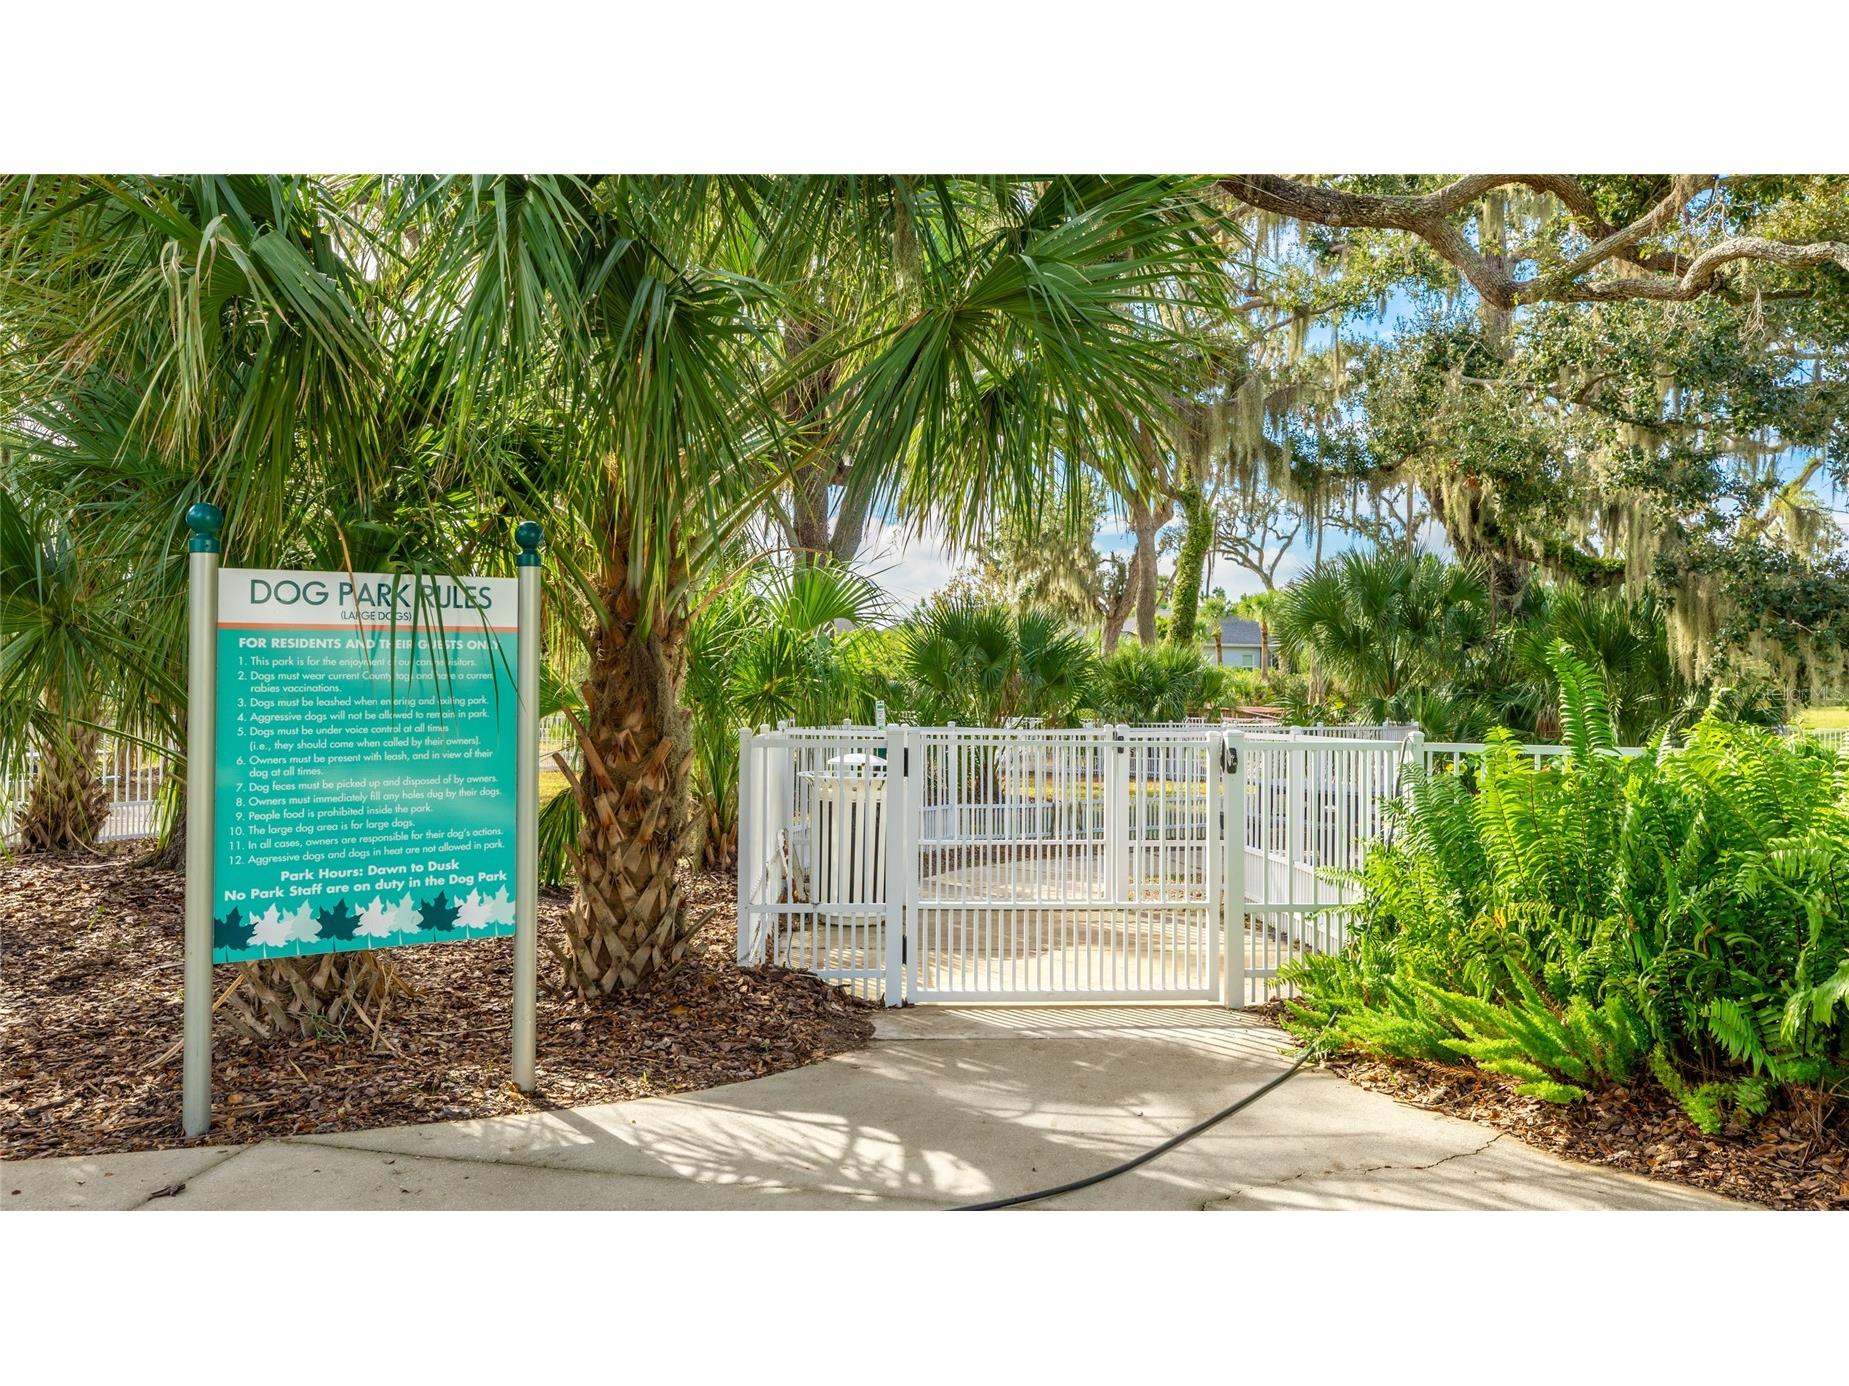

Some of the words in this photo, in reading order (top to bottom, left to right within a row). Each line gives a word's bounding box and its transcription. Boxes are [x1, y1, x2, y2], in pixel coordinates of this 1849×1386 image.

[251, 580, 328, 605] DOG
[339, 582, 411, 607] PARK
[421, 584, 492, 609] RULES
[239, 638, 266, 648] FOR
[272, 638, 341, 648] RESIDENTS
[346, 639, 375, 649] AND
[239, 657, 247, 665] 1.
[251, 656, 269, 665] This
[272, 656, 294, 668] park
[307, 657, 320, 666] for
[323, 657, 336, 666] the
[237, 671, 247, 680] 2.
[251, 671, 275, 682] Dogs
[278, 672, 302, 680] must
[328, 672, 359, 680] current
[251, 684, 280, 693] rabies
[283, 684, 342, 693] vaccinations.
[237, 698, 246, 707] 3.
[251, 698, 275, 709] Dogs
[302, 698, 313, 706] be
[316, 696, 350, 706] leashed
[354, 697, 377, 705] when
[419, 696, 435, 704] and
[468, 696, 488, 706] park.
[237, 713, 246, 721] 4.
[250, 712, 301, 724] Aggressive
[305, 711, 327, 722] dogs
[330, 711, 345, 720] will
[348, 712, 362, 720] not
[379, 710, 412, 719] allowed
[468, 709, 489, 720] park.
[237, 727, 246, 736] 5.
[250, 727, 274, 737] Dogs
[278, 727, 298, 735] must
[302, 726, 313, 735] be
[316, 725, 342, 734] under
[345, 726, 368, 734] voice
[371, 724, 400, 733] control
[415, 723, 424, 732] all
[275, 740, 294, 751] they
[297, 739, 327, 749] should
[357, 739, 380, 747] when
[383, 737, 409, 747] called
[412, 737, 422, 748] by
[425, 736, 444, 745] their
[446, 736, 481, 745] owners).
[237, 757, 246, 765] 6.
[249, 755, 286, 764] Owners
[290, 755, 311, 763] must
[314, 754, 325, 763] be
[328, 754, 360, 764] present
[363, 751, 381, 761] with
[384, 751, 410, 761] leash,
[413, 750, 430, 759] and
[474, 749, 493, 757] their
[249, 768, 268, 779] dog
[271, 768, 280, 776] at
[283, 767, 294, 776] all
[298, 767, 323, 775] times.
[236, 783, 245, 792] 7.
[249, 783, 269, 793] Dog
[272, 781, 295, 790] feces
[299, 782, 320, 790] must
[323, 780, 334, 789] be
[337, 778, 366, 791] picked
[369, 780, 380, 788] up
[383, 778, 400, 786] and
[403, 776, 440, 787] disposed
[454, 775, 464, 785] by
[467, 775, 498, 783] owners.
[236, 797, 245, 806] 8.
[249, 797, 286, 806] Owners
[289, 796, 310, 804] must
[313, 792, 367, 803] immediately
[371, 791, 380, 800] fill
[384, 793, 399, 802] any
[403, 790, 424, 799] holes
[427, 789, 443, 799] dug
[446, 789, 456, 799] by
[459, 788, 477, 796] their
[480, 787, 501, 797] dogs.
[236, 812, 245, 821] 9.
[249, 811, 280, 822] People
[284, 808, 304, 818] food
[317, 806, 364, 819] prohibited
[367, 805, 392, 814] inside
[395, 804, 408, 813] the
[411, 803, 432, 815] park.
[230, 827, 244, 835] 10.
[249, 825, 265, 835] The
[269, 824, 293, 835] large
[296, 823, 313, 834] dog
[317, 823, 338, 831] area
[351, 820, 363, 829] for
[366, 819, 389, 830] large
[392, 818, 415, 829] dogs.
[229, 841, 244, 850] 11.
[249, 841, 256, 850] In
[260, 839, 271, 849] all
[275, 839, 302, 848] cases,
[306, 838, 338, 846] owners
[341, 836, 356, 845] are
[359, 832, 408, 844] responsible
[411, 831, 423, 840] for
[426, 830, 444, 839] their
[447, 829, 470, 839] dog's
[473, 828, 503, 836] actions.
[229, 856, 244, 864] 12.
[248, 853, 299, 865] Aggressive
[303, 851, 325, 862] dogs
[328, 848, 345, 858] and
[349, 848, 370, 859] dogs
[373, 848, 381, 856] in
[384, 846, 403, 855] heat
[406, 846, 421, 854] are
[423, 845, 437, 853] not
[438, 842, 471, 852] allowed
[484, 839, 504, 851] park.
[281, 869, 314, 881] Park
[319, 868, 363, 879] Hours:
[368, 864, 406, 875] Dawn
[411, 863, 423, 872] to
[428, 859, 459, 871] Dusk
[224, 890, 246, 900] No
[251, 886, 284, 899] Park
[289, 883, 323, 897] Staff
[326, 883, 349, 893] are
[354, 881, 370, 892] on
[375, 879, 404, 891] duty
[409, 877, 420, 888] in
[425, 876, 445, 886] the
[449, 874, 474, 885] Dog
[478, 870, 507, 882] Park
